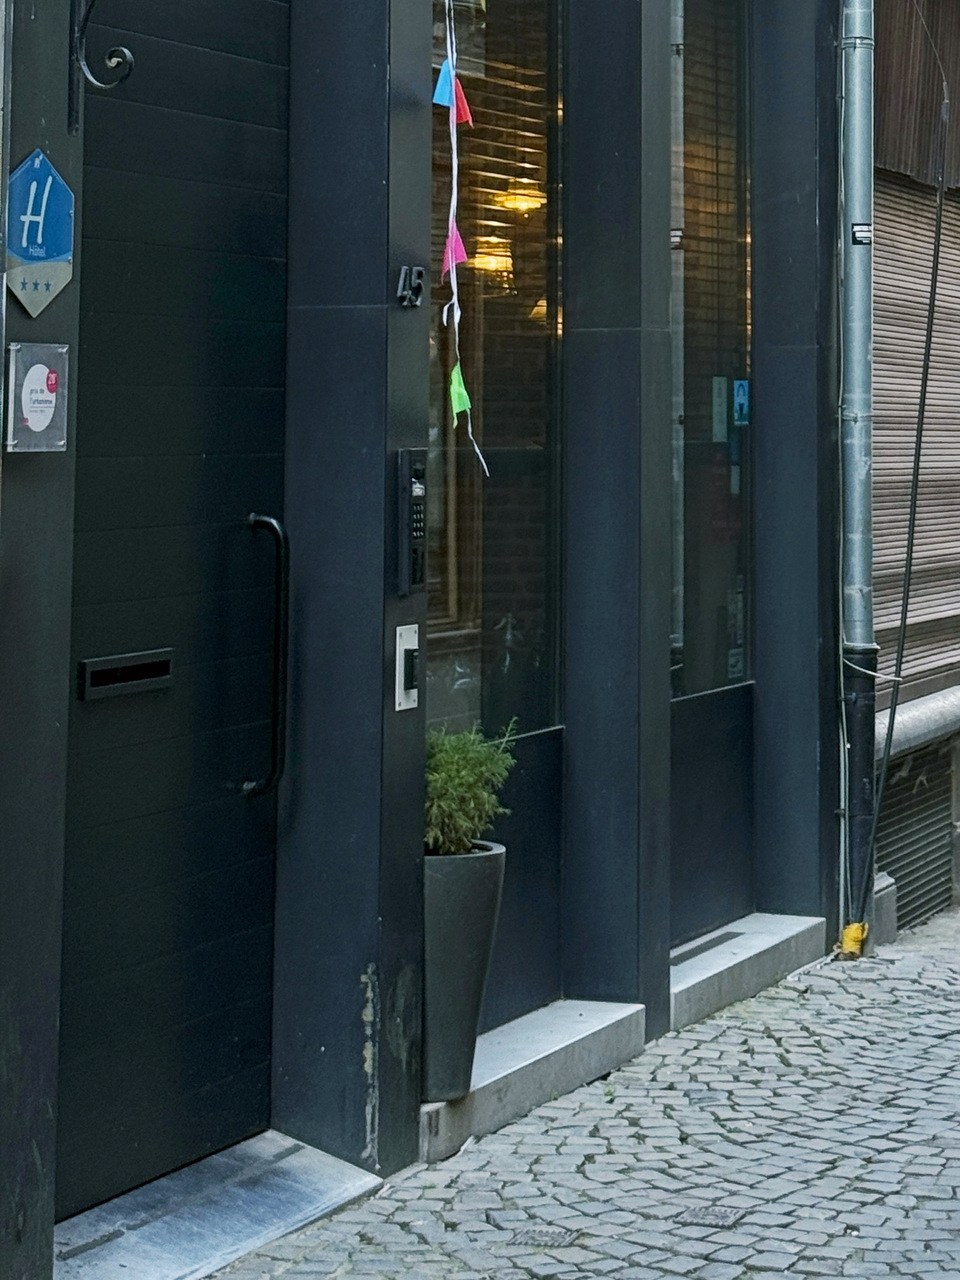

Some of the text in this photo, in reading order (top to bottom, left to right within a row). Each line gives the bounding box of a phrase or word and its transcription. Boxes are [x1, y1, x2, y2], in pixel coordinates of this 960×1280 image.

[20, 175, 53, 248] H
[29, 244, 47, 257] Hôtel
[397, 265, 425, 307] 45
